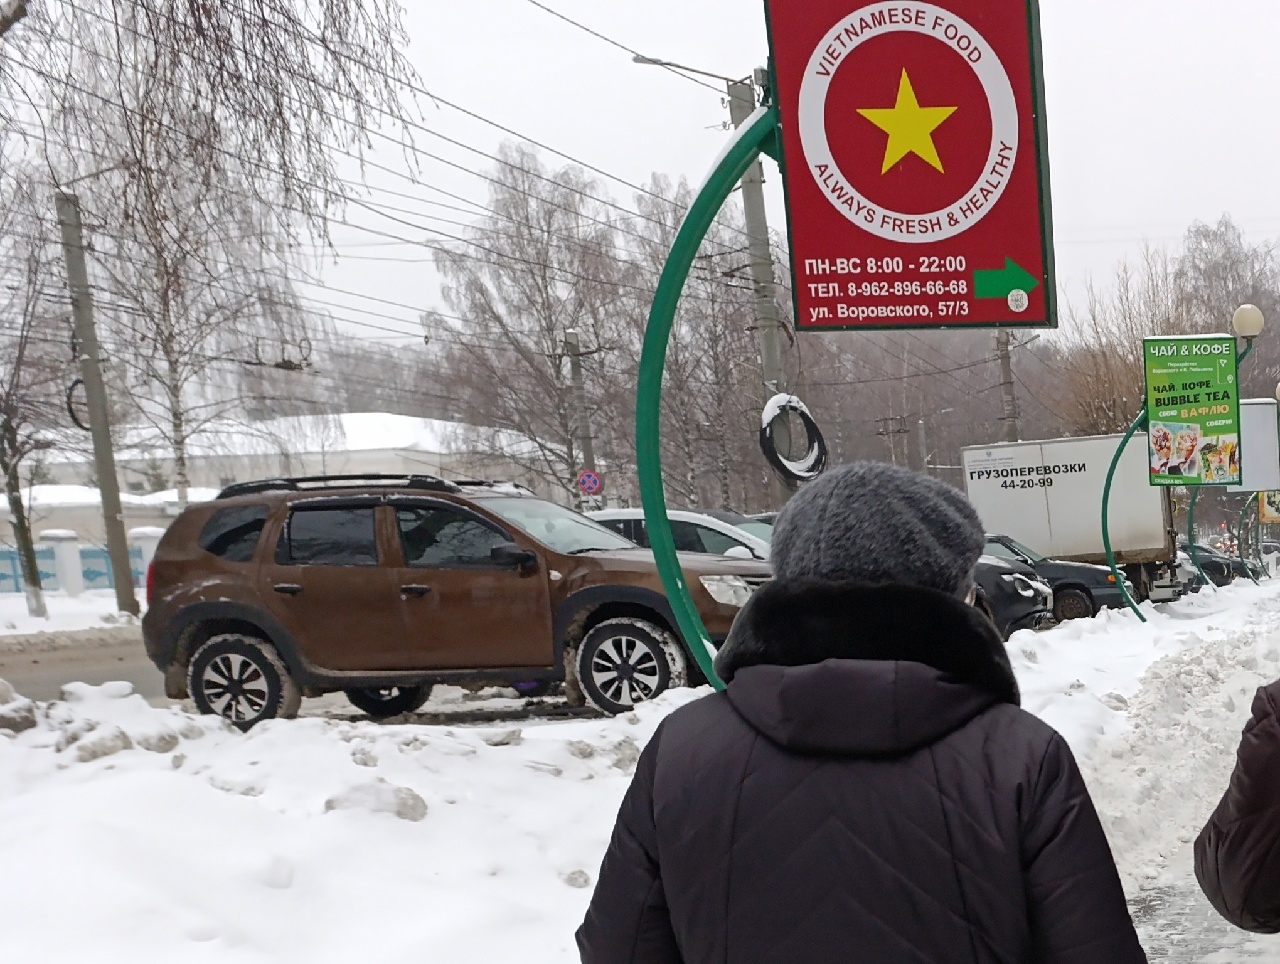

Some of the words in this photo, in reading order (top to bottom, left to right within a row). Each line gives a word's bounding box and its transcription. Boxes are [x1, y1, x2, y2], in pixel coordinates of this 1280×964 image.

[816, 8, 926, 78] VIETNAMESE
[932, 16, 982, 64] FOOD
[815, 163, 875, 223] ALWAYS
[880, 215, 942, 234] FRESH
[947, 213, 960, 227] &
[959, 141, 1013, 219] HEALTHY
[805, 257, 861, 275] ПН-ВС
[866, 256, 903, 273] 8:00
[919, 256, 966, 273] 22:00
[808, 282, 844, 298] ТЕЛ.
[847, 280, 968, 296] 8-962-896-66-68
[809, 305, 833, 321] ул.
[837, 303, 934, 320] Воровского,
[938, 302, 969, 316] 57/3
[1150, 343, 1177, 357] ЧАЙ
[1180, 345, 1190, 356] &
[1193, 343, 1230, 355] КОФЕ
[1155, 393, 1200, 407] BUBBLE
[1205, 390, 1231, 402] TEA
[1180, 404, 1230, 418] ВАФЛЮ
[970, 464, 1086, 480] ГРУЗОПЕРЕВОЗКИ
[1001, 478, 1053, 489] 44-20-99
